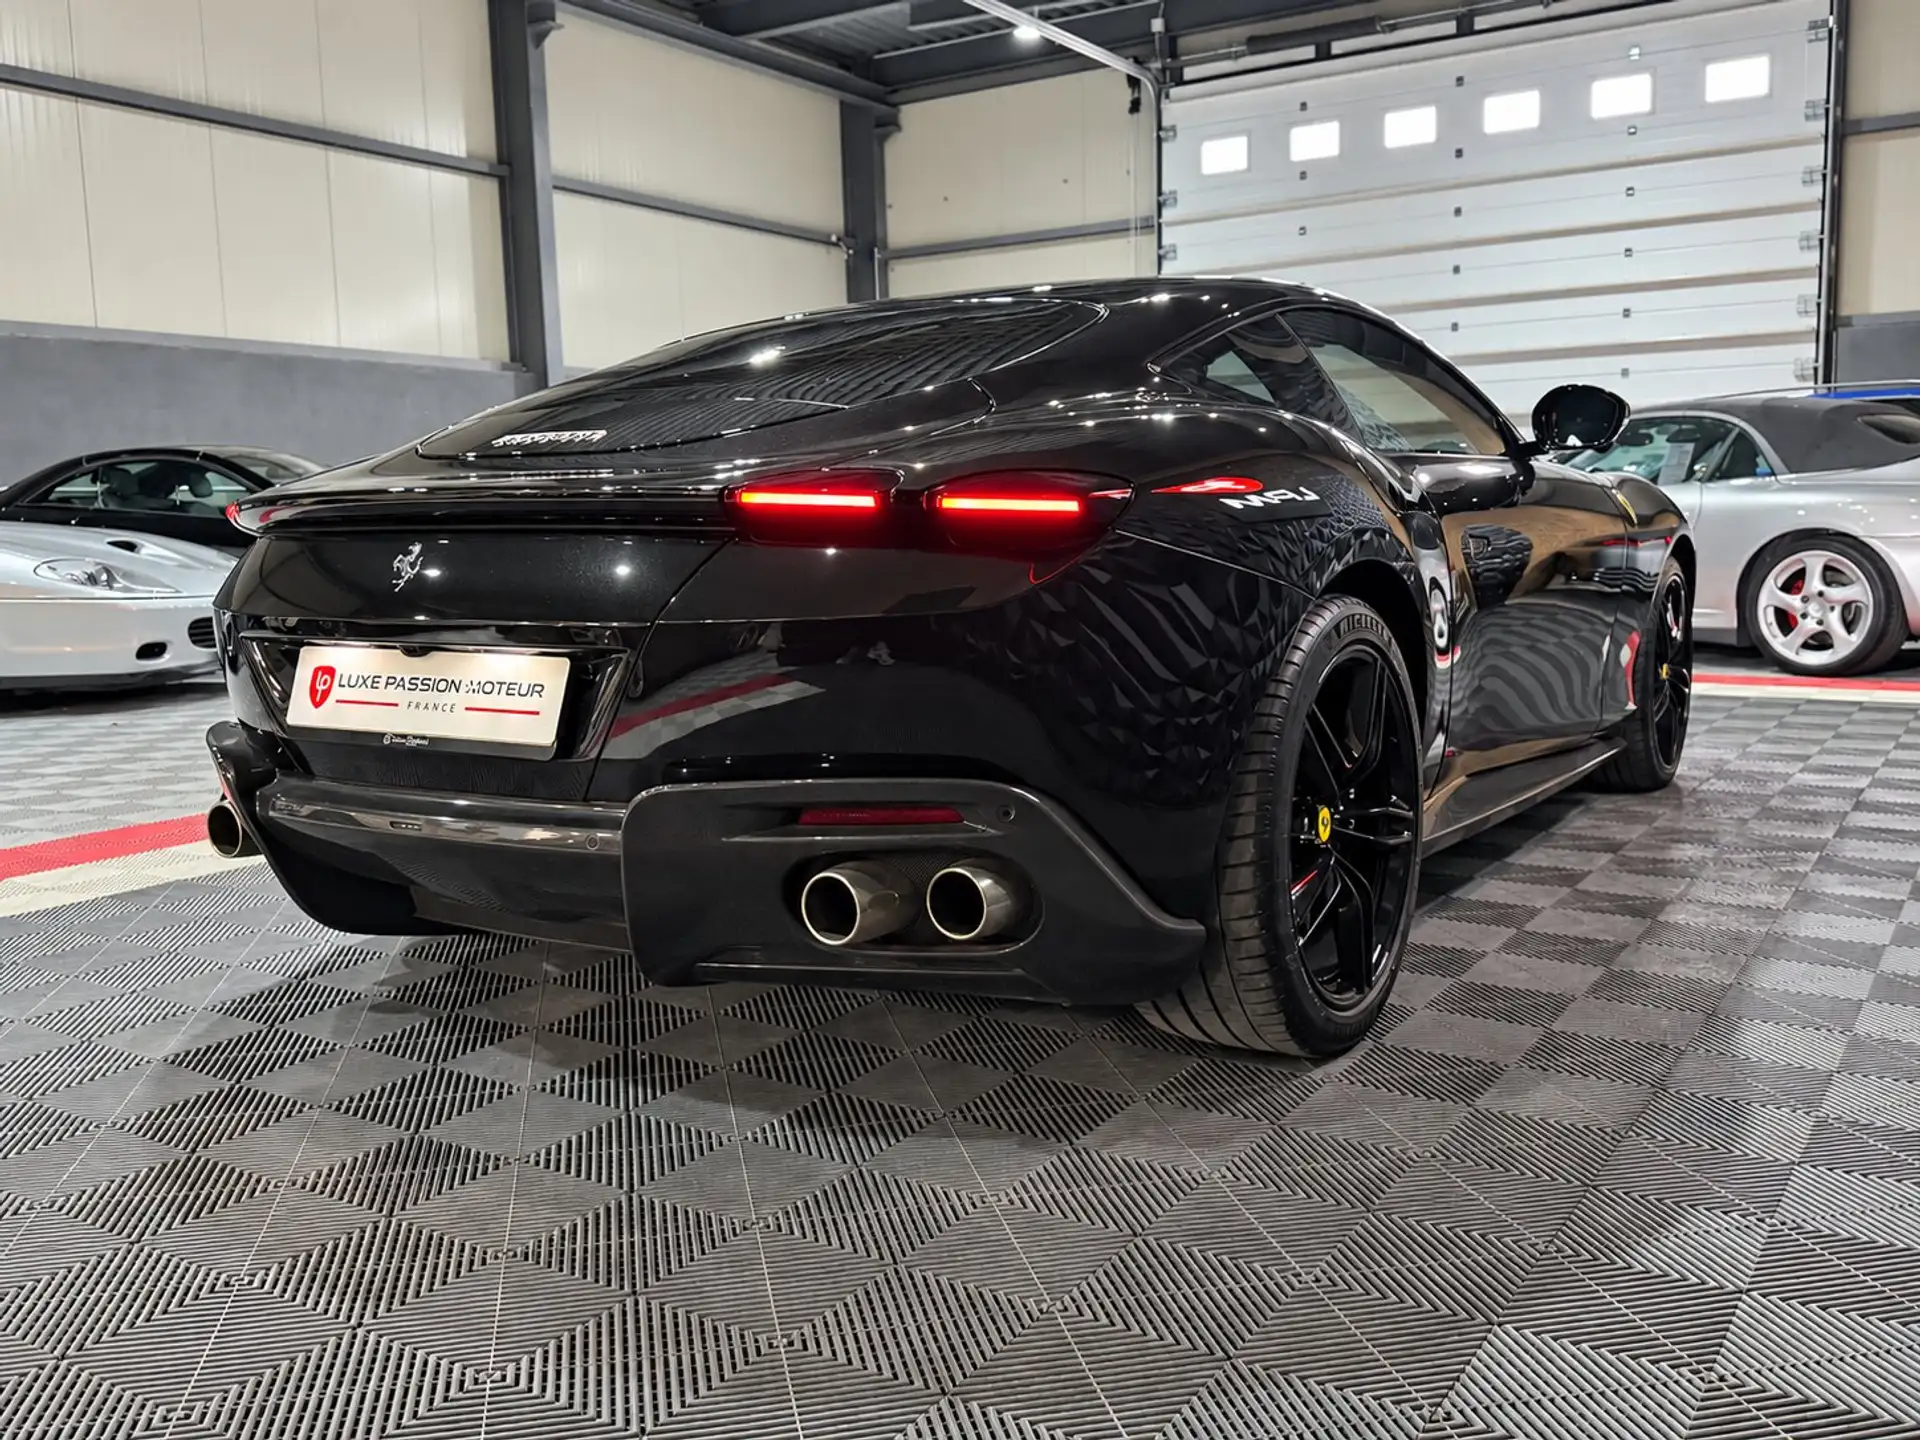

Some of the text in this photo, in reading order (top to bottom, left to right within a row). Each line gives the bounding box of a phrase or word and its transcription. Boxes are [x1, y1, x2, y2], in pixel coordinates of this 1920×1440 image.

[337, 673, 545, 698] LUXE PASSION MOTEUR
[406, 701, 457, 714] FRANCE
